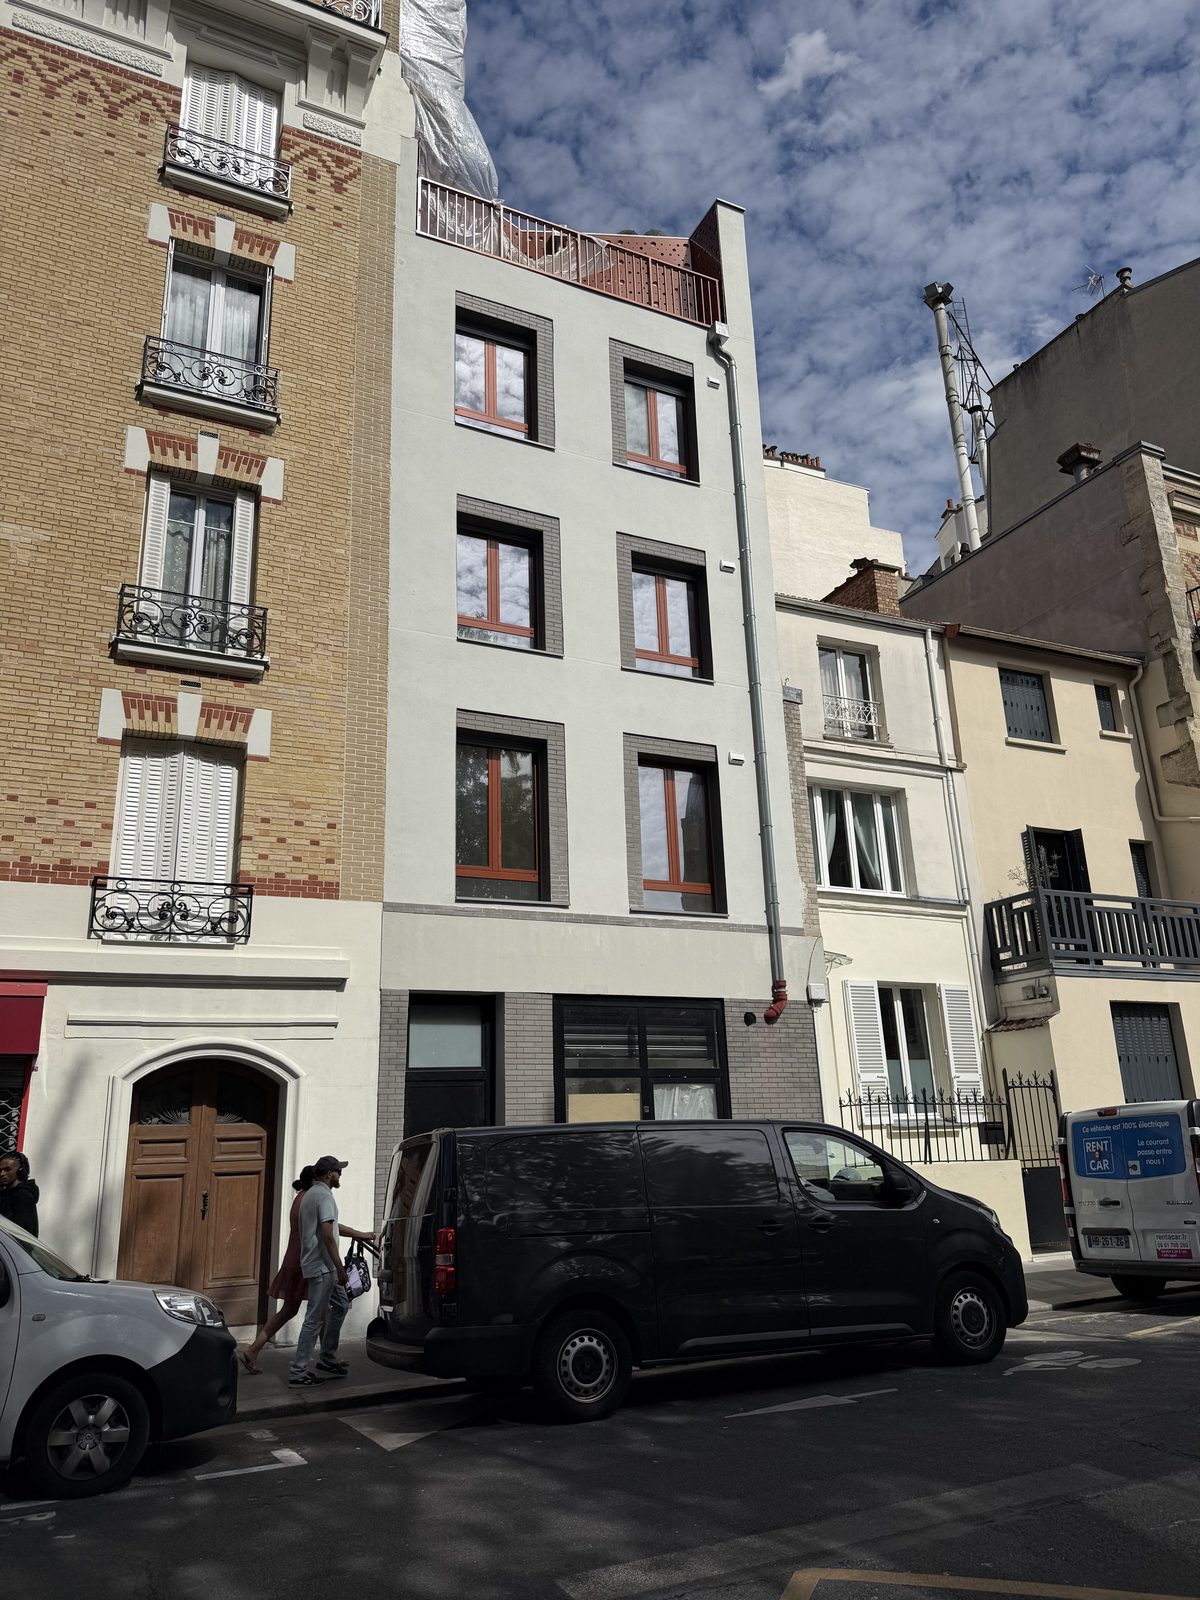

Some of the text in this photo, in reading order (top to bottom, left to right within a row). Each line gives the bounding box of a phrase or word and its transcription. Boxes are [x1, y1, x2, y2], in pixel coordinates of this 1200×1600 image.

[1090, 1124, 1111, 1132] véhicule
[1138, 1121, 1169, 1129] électrique
[1085, 1140, 1109, 1152] RENT
[1145, 1138, 1169, 1146] courant
[1137, 1149, 1155, 1157] passe
[1089, 1159, 1110, 1171] CAR
